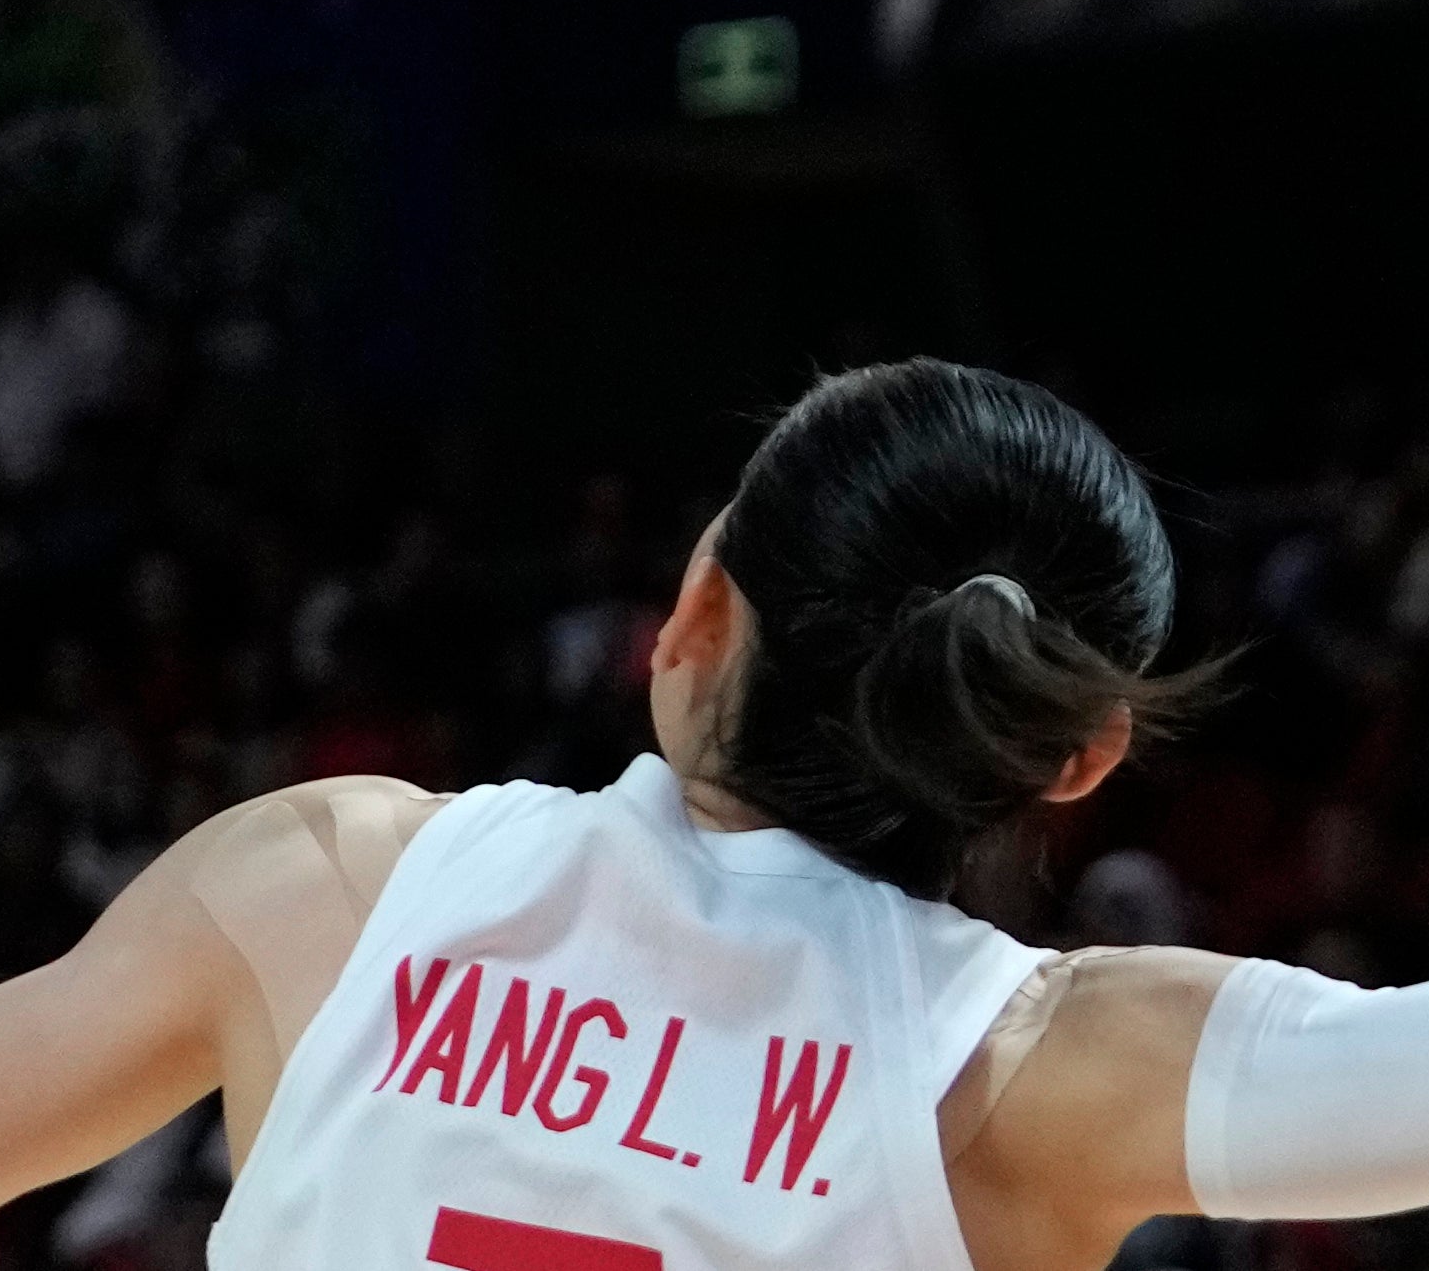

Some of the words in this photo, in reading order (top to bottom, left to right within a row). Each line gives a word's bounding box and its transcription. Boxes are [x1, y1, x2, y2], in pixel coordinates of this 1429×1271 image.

[373, 954, 628, 1133] YANG
[619, 1016, 702, 1168] L.
[742, 1034, 853, 1197] W.
